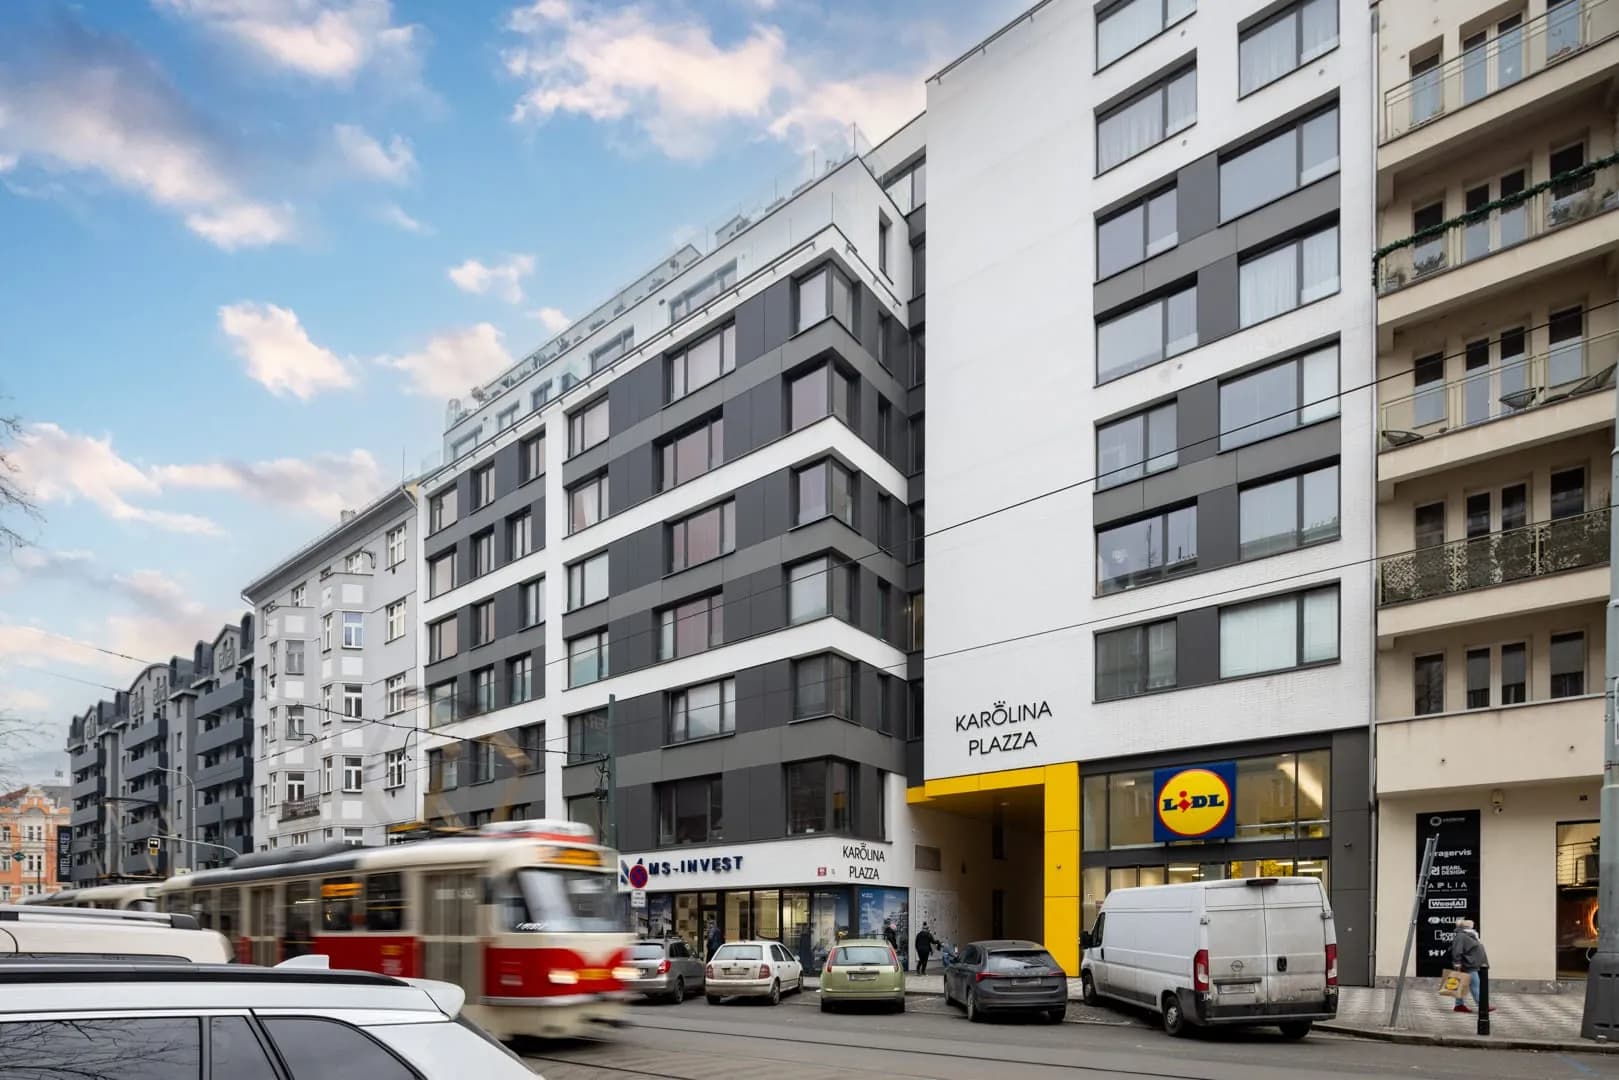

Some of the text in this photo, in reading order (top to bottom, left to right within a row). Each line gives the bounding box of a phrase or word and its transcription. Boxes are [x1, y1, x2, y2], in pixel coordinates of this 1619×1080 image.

[968, 730, 1038, 757] PLAZZA
[648, 855, 744, 876] MS-INVEST
[849, 865, 880, 880] PLAZZA
[1428, 881, 1467, 889] APLIA
